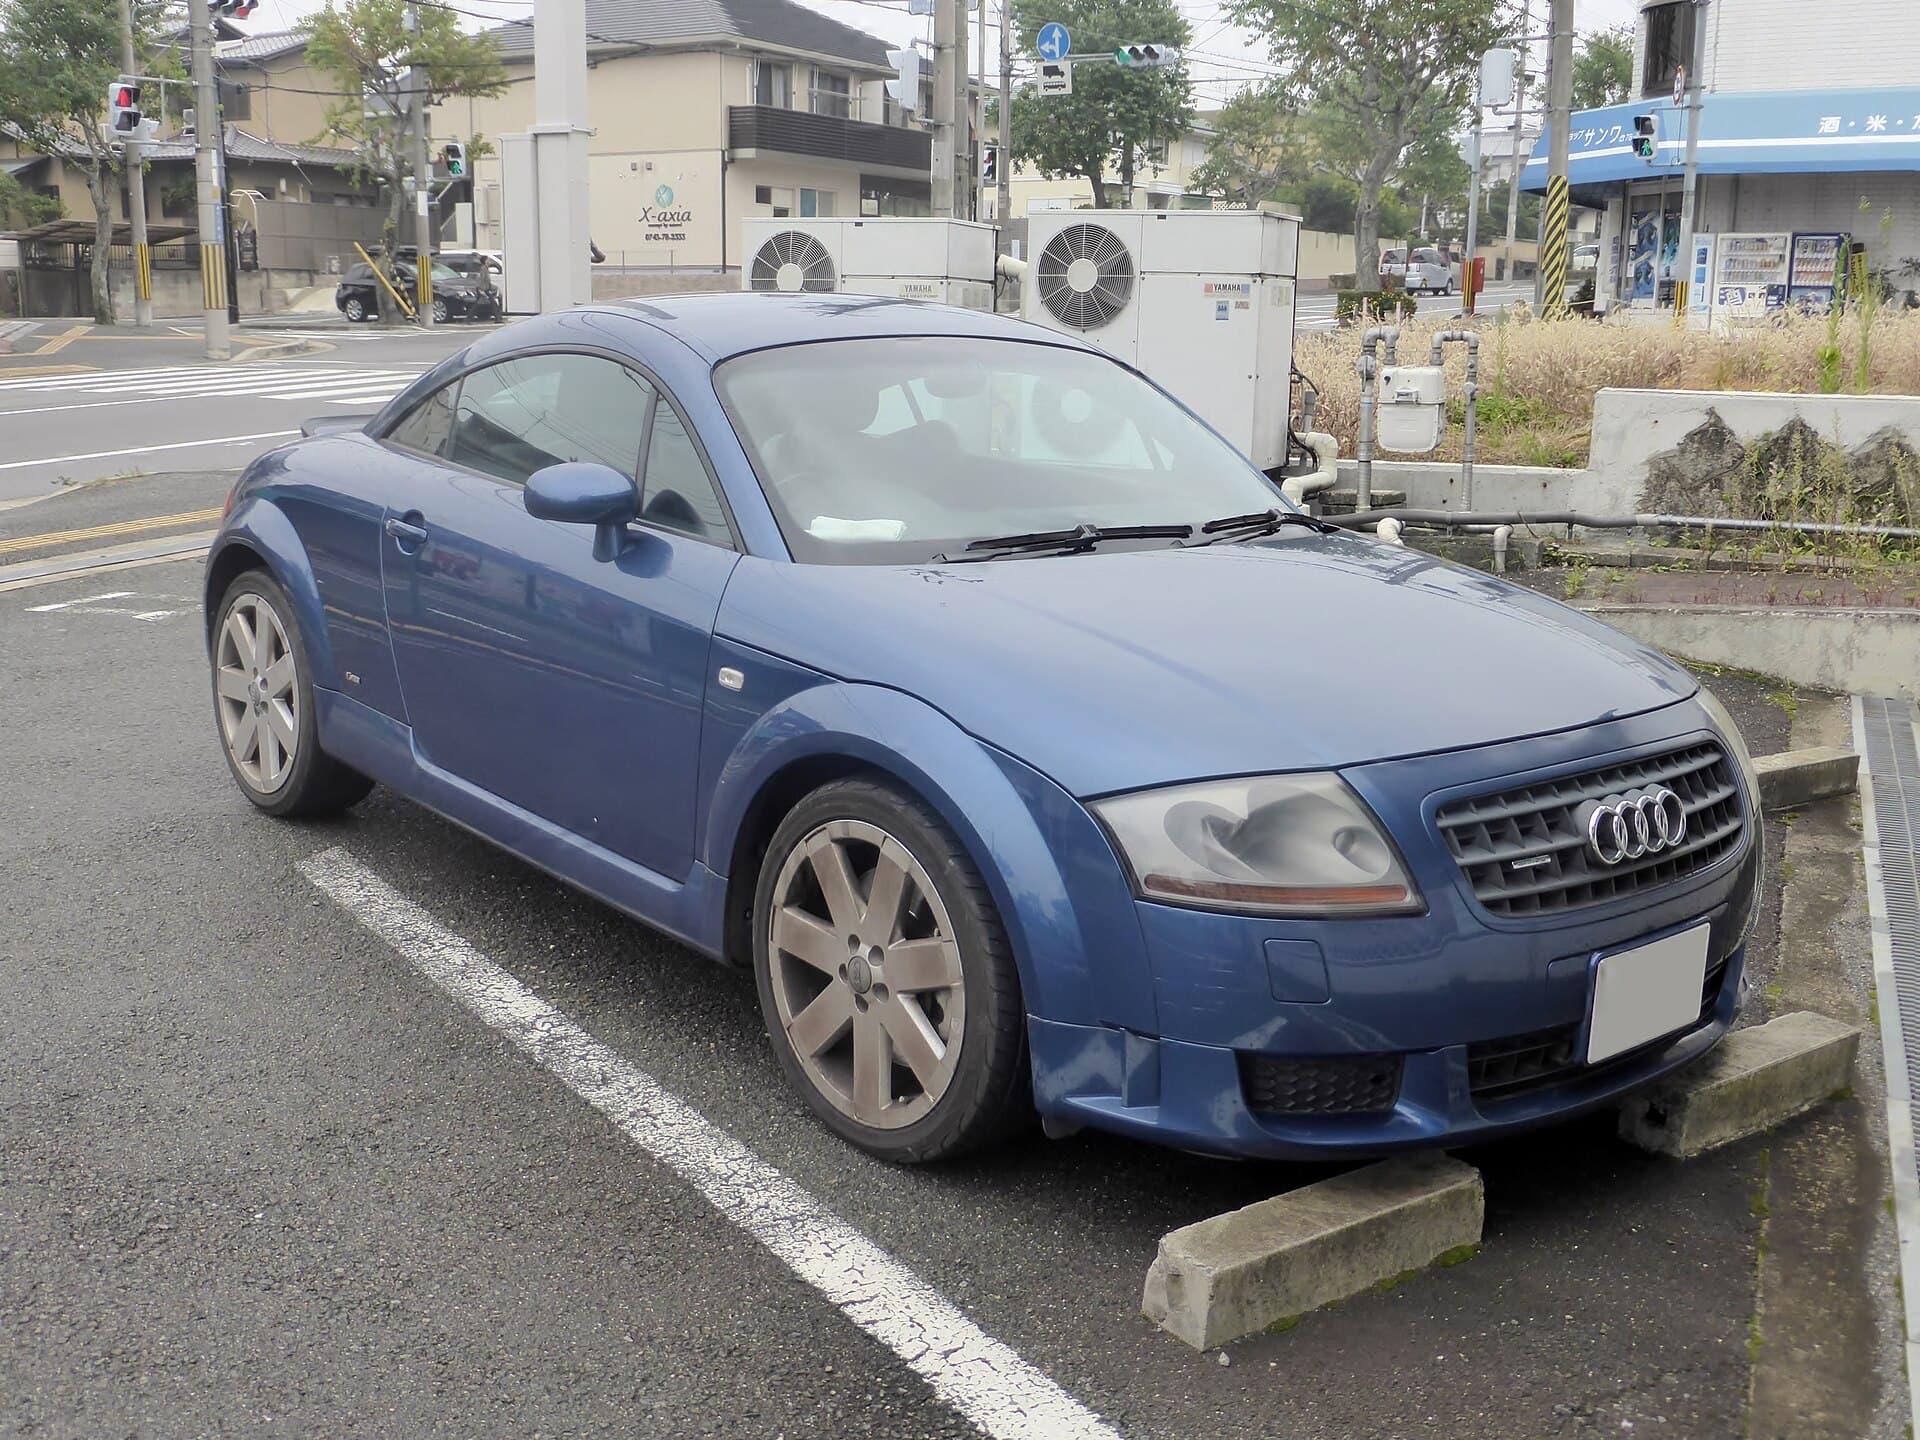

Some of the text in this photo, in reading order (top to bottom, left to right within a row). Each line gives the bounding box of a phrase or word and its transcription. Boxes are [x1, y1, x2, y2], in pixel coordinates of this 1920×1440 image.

[638, 205, 692, 222] X-axia
[904, 284, 932, 293] YAMAHA
[1213, 283, 1241, 291] YAMAHA
